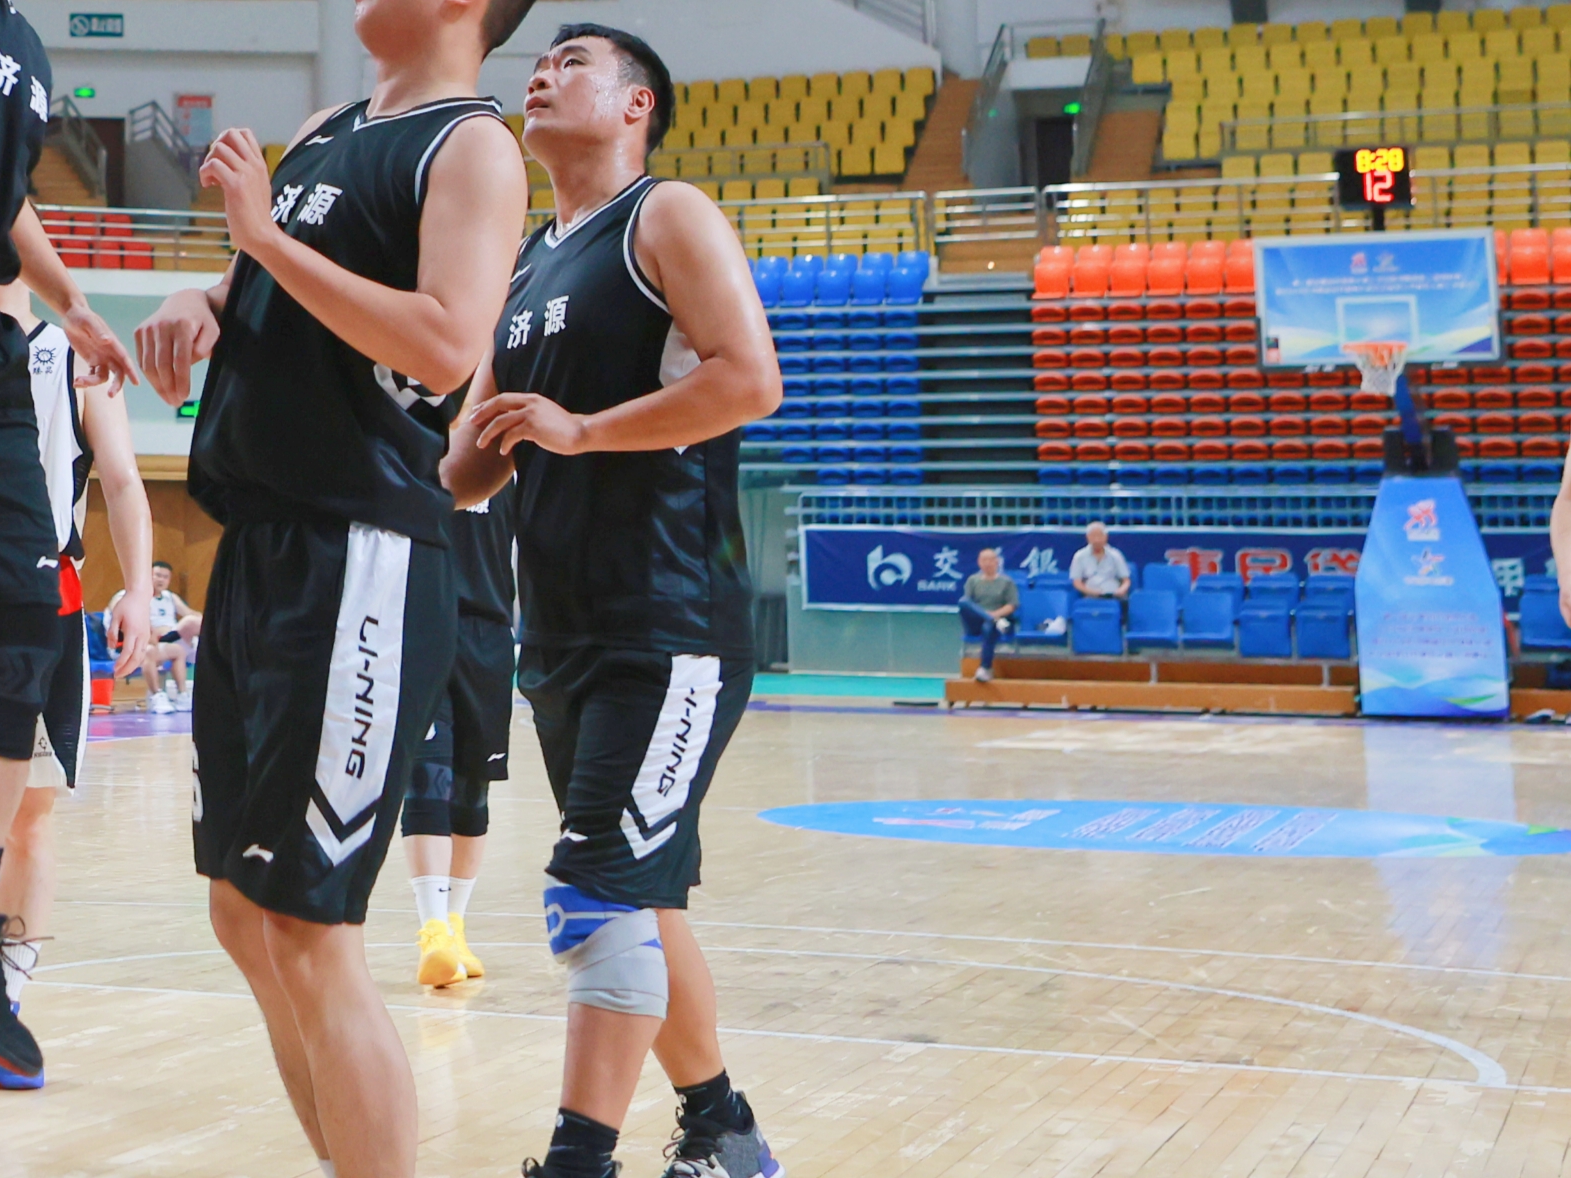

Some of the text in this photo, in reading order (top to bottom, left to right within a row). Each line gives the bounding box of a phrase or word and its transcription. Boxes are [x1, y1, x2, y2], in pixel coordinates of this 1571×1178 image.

[1362, 170, 1396, 202] 12
[506, 294, 570, 350] 济源
[345, 614, 379, 780] LI-NING
